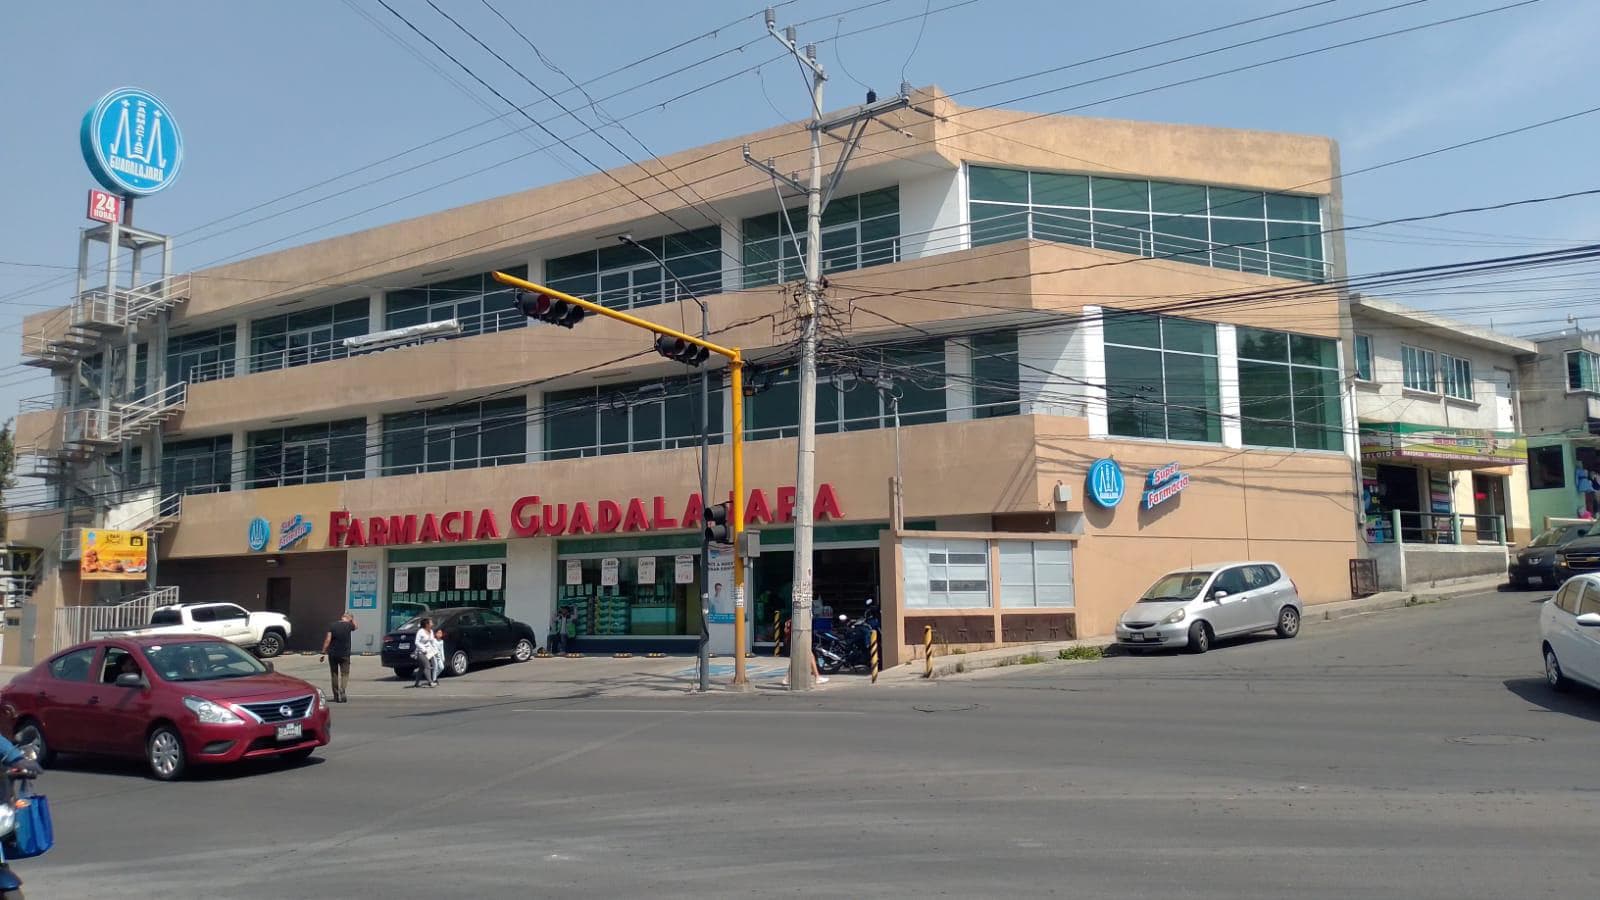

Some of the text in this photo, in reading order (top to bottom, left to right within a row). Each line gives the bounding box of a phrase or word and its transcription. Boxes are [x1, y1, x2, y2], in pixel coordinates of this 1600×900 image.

[110, 155, 164, 182] GUADALAJARA
[94, 208, 117, 221] HORAS
[96, 193, 116, 212] 24
[1154, 462, 1179, 484] Super
[1147, 474, 1190, 508] Farmacia
[329, 483, 843, 547] FARMACIA GUADALAARA
